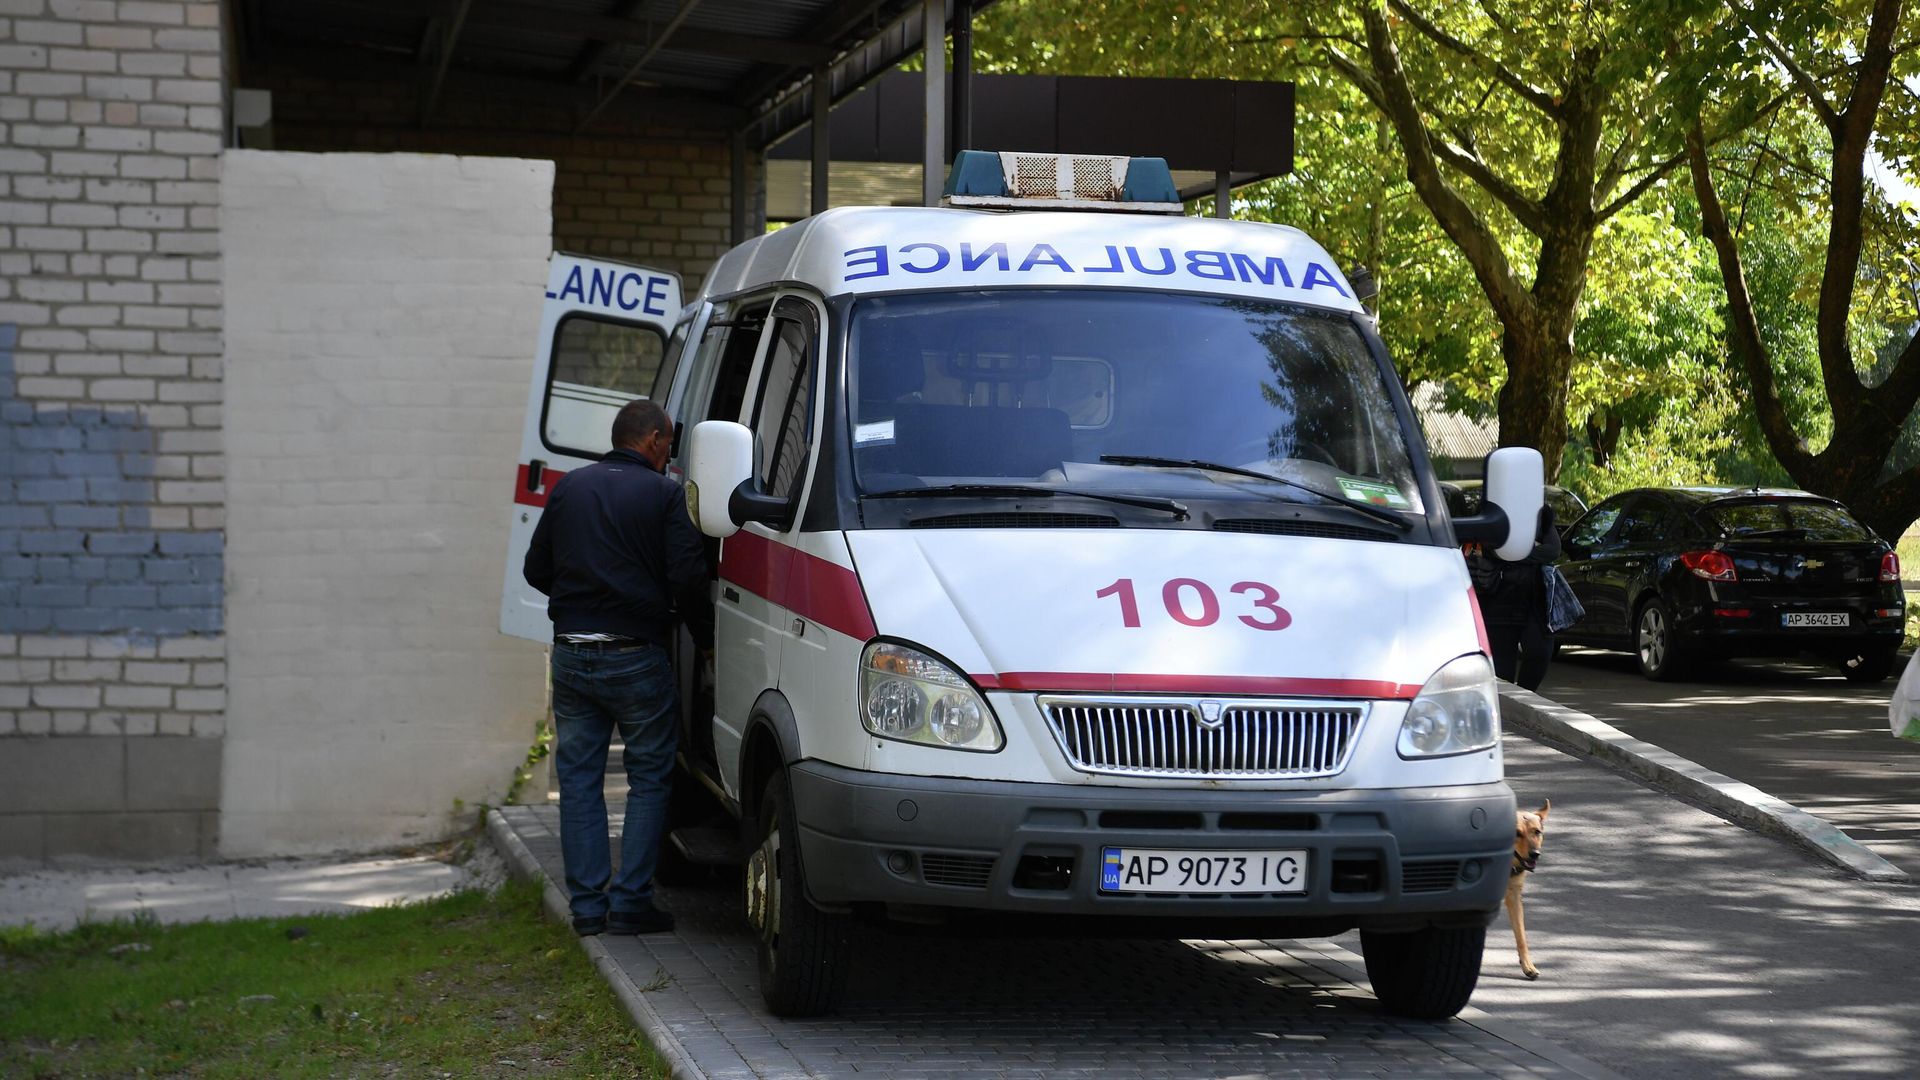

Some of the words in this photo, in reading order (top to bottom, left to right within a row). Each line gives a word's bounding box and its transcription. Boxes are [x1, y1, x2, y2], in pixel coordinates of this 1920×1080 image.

[1096, 577, 1292, 631] 103
[1788, 614, 1802, 625] AP
[1805, 614, 1829, 625] 3642
[1831, 614, 1846, 625] EX
[1104, 874, 1118, 885] UA
[1125, 856, 1169, 885] AP
[1178, 857, 1247, 886] 9073
[1262, 857, 1298, 885] IC
